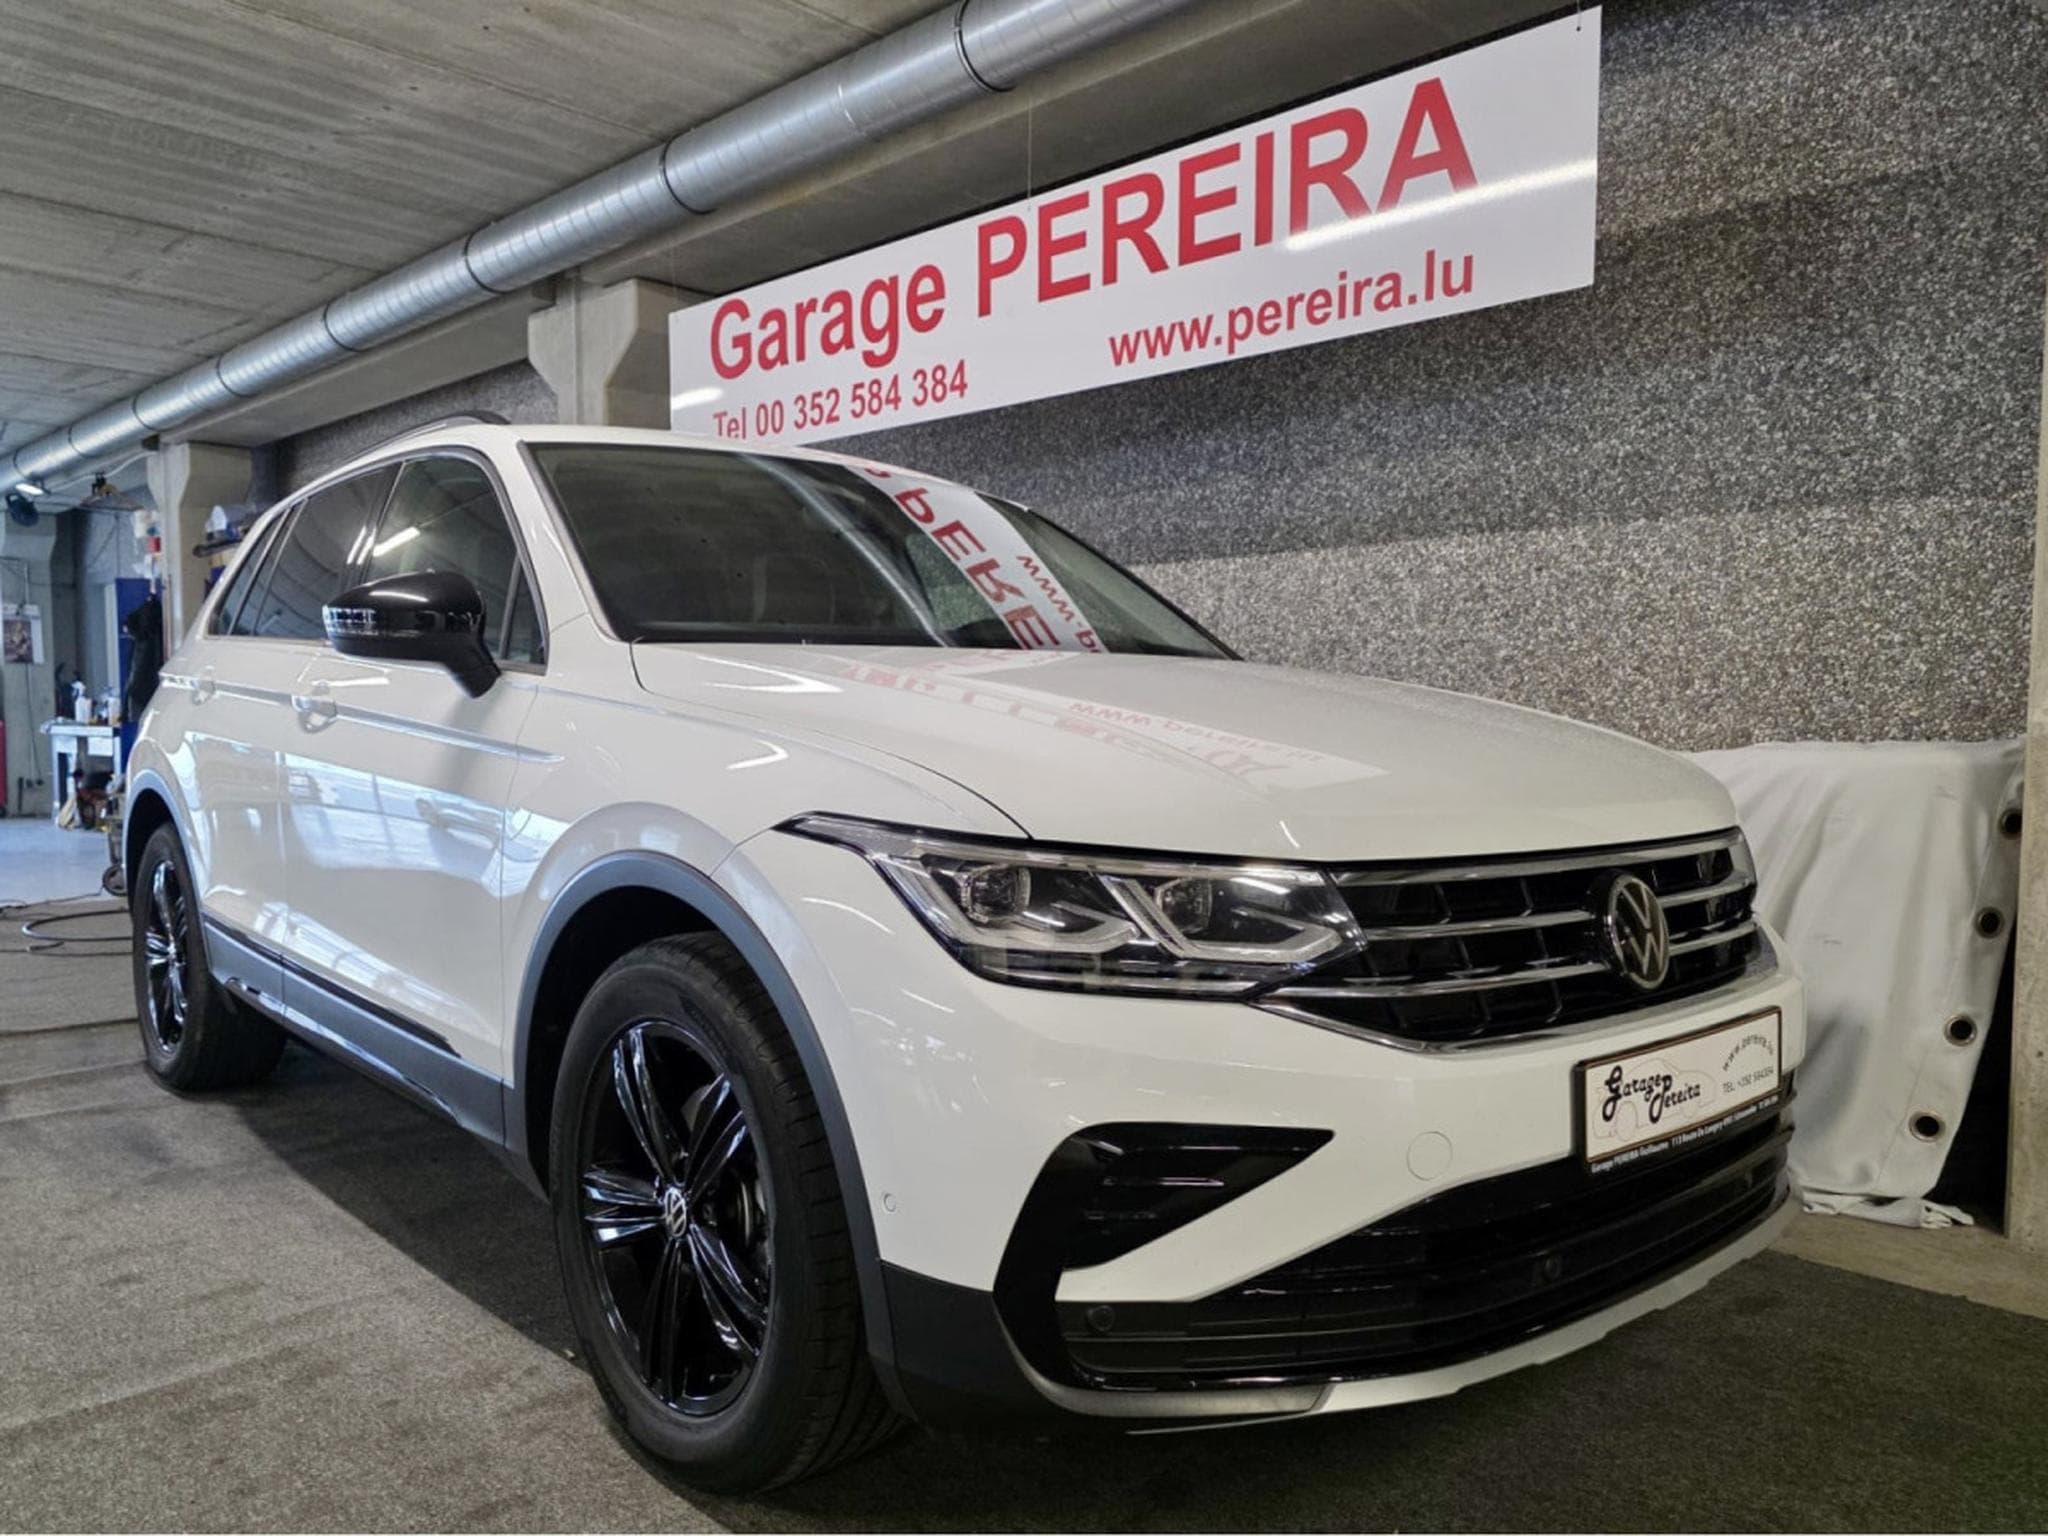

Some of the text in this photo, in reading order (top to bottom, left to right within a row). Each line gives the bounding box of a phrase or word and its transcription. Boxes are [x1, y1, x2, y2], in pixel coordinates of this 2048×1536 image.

[709, 76, 1479, 381] Garage PEREIRA
[1108, 249, 1475, 368] www.pereira.lu
[712, 360, 968, 439] Tel 00 352 584 384
[1602, 1065, 1661, 1122] Garage
[1649, 1074, 1701, 1124] Pereira
